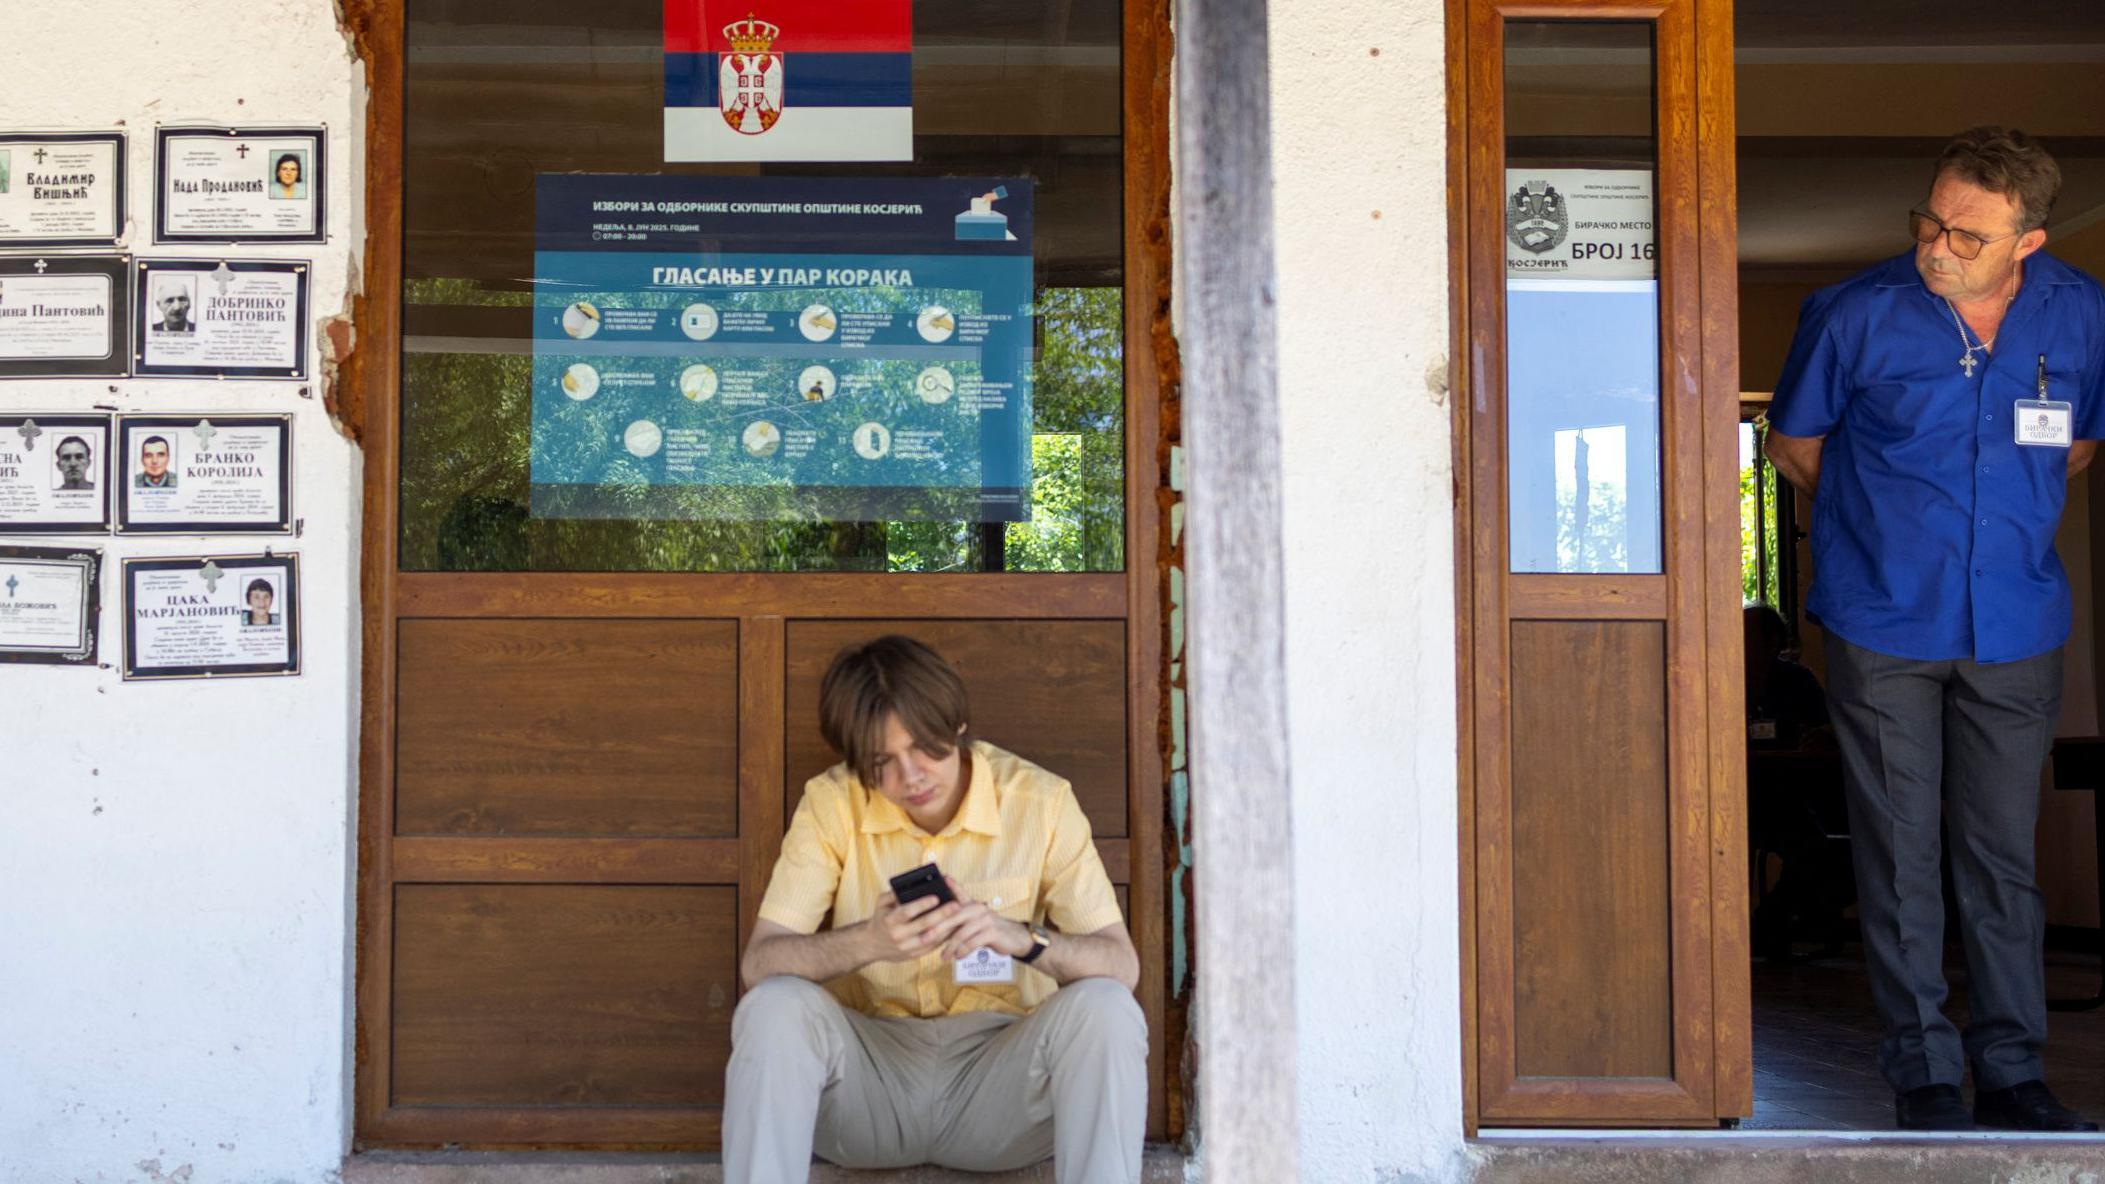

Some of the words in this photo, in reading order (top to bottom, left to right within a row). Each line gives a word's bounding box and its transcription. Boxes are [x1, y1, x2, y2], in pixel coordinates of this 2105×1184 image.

[27, 172, 95, 186] Владимир
[34, 187, 88, 199] Вишњић
[173, 179, 199, 194] Нада
[202, 178, 263, 195] Продановић
[593, 201, 639, 212] ИЗБОРИ
[641, 202, 655, 212] ЗА
[657, 202, 728, 214] ОДБОРНИКЕ
[730, 202, 801, 213] СКУПШТИНЕ
[803, 203, 861, 214] ОПШТИНЕ
[863, 204, 923, 215] КОСЈЕРИЋ
[1575, 221, 1618, 230] БИРАЧКО
[1620, 221, 1652, 230] МЕСТО
[1572, 242, 1623, 260] БРОЈ
[1631, 243, 1656, 260] 16
[653, 267, 756, 285] ГЛАСАЊЕ
[760, 268, 774, 285] У
[778, 268, 822, 286] ПАР
[826, 269, 913, 287] КОРАКА
[207, 296, 286, 309] ДОБРИНКО
[0, 307, 27, 317] ина
[32, 304, 104, 317] Пантовић
[206, 310, 286, 322] ПАНТОВИЋ
[195, 452, 254, 464] БРАНКО
[187, 466, 263, 478] КОРОЛИЈА
[167, 595, 209, 606] ЦАКА
[137, 605, 241, 619] МАРЈАНОВИЋ
